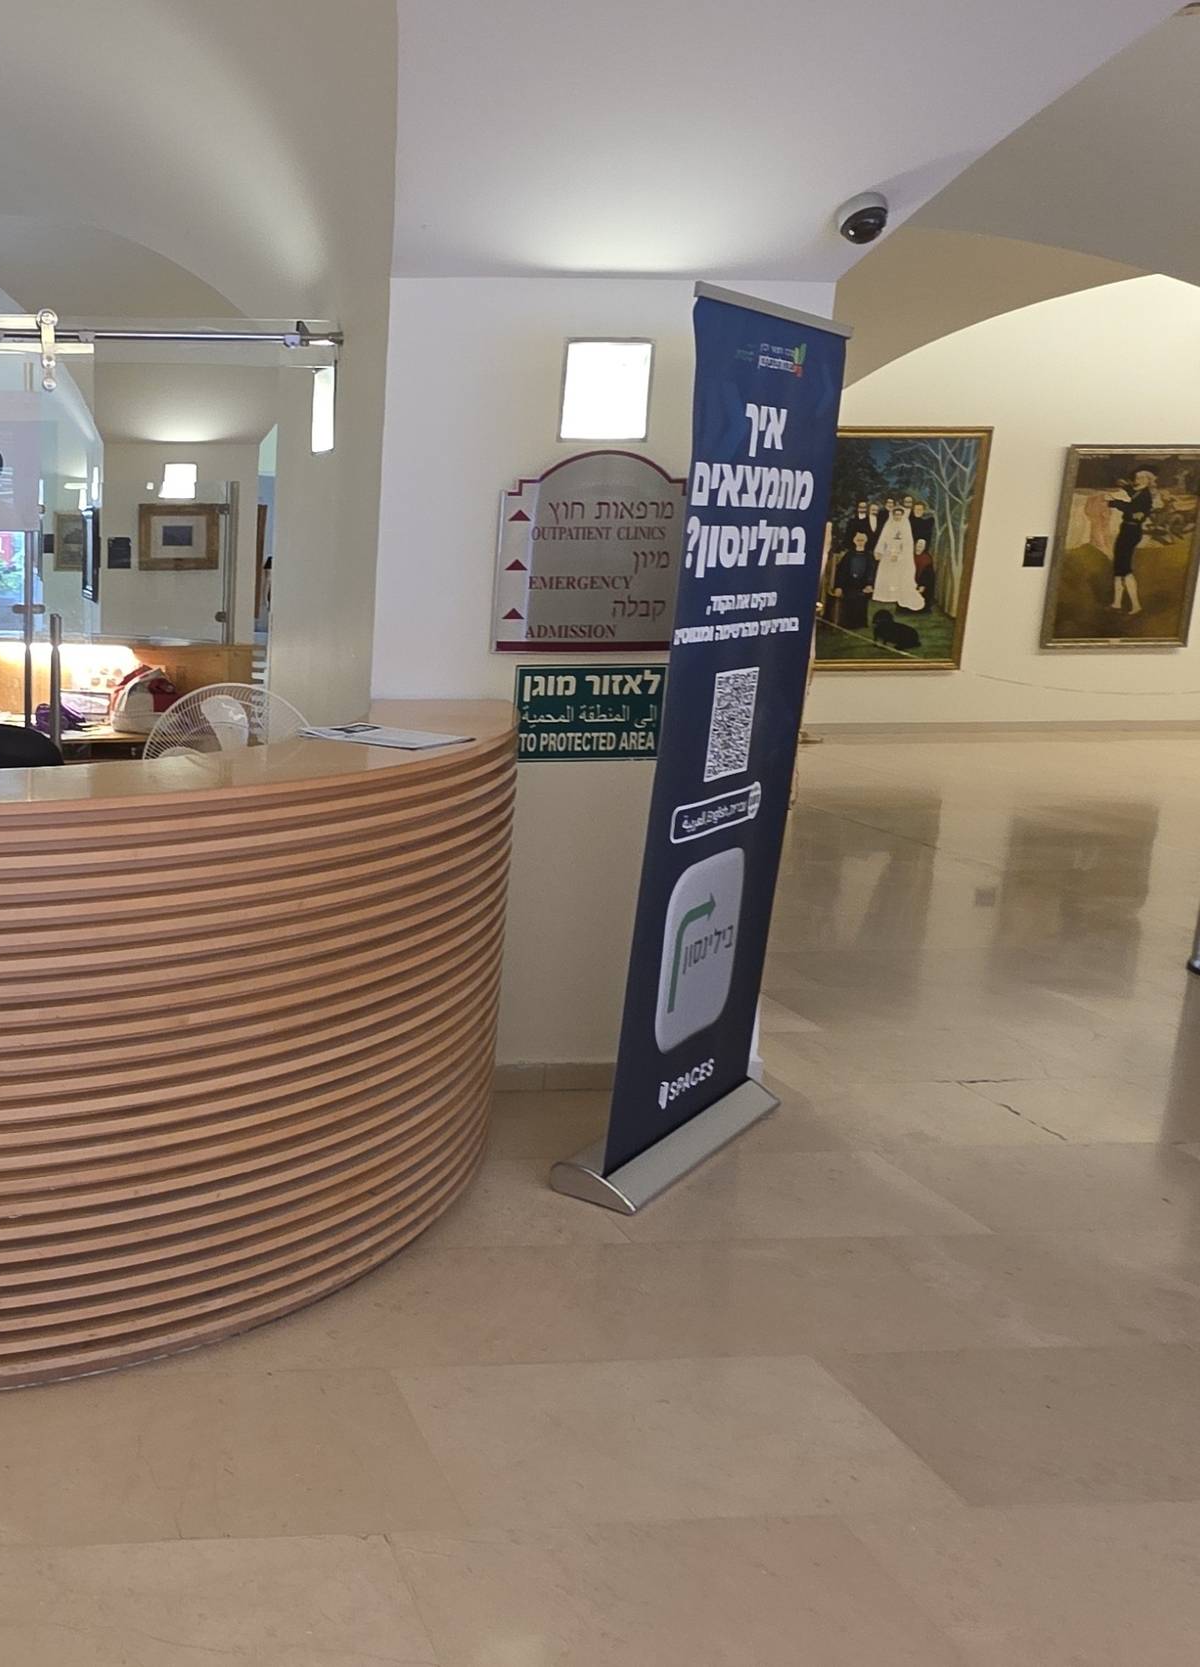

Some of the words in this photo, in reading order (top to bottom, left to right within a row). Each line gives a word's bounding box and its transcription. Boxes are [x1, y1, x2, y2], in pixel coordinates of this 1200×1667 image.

[746, 403, 787, 457] איך
[691, 462, 814, 510] מתמצאים
[548, 501, 585, 525] חוץ
[594, 501, 674, 519] מרפאות
[531, 526, 612, 541] OUTPATIENT
[616, 526, 667, 540] CLINICS
[685, 516, 807, 578] בבילינסון?
[633, 551, 670, 574] מיון
[528, 575, 634, 590] EMERGENCY
[611, 595, 667, 622] קבלה
[525, 624, 617, 639] ADMISSION
[522, 675, 577, 702] מוגן
[584, 669, 661, 695] לאזור
[522, 704, 574, 728] المحمية
[579, 704, 630, 722] المنطقة
[519, 733, 537, 752] TO
[540, 732, 616, 751] PROTECTED
[619, 731, 655, 750] AREA
[682, 925, 734, 975] בילינסון
[669, 1058, 715, 1100] SPACES
